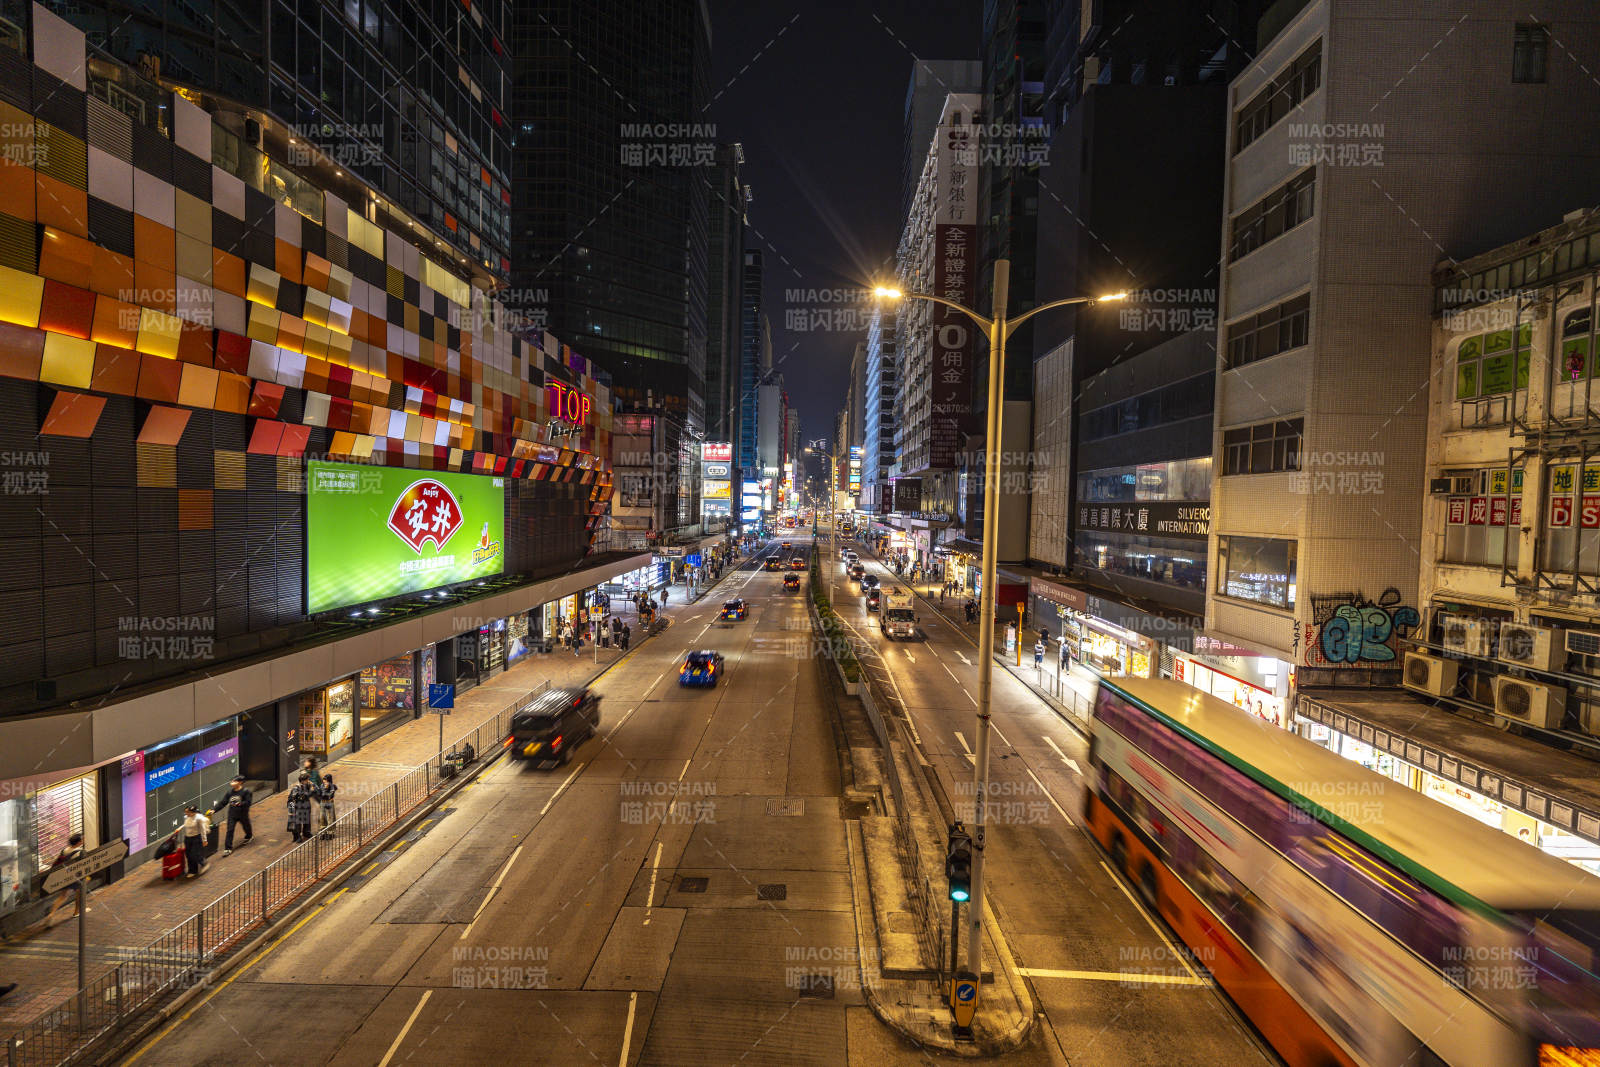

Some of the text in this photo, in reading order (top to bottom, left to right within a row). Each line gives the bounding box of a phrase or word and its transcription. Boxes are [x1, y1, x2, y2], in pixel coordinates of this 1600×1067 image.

[545, 380, 590, 426] TOP
[423, 486, 440, 498] Anjoy
[1494, 471, 1505, 492] 招生
[405, 498, 451, 540] 安井
[1080, 508, 1150, 531] 銀高國際大廈
[1178, 507, 1210, 520] SILVERC
